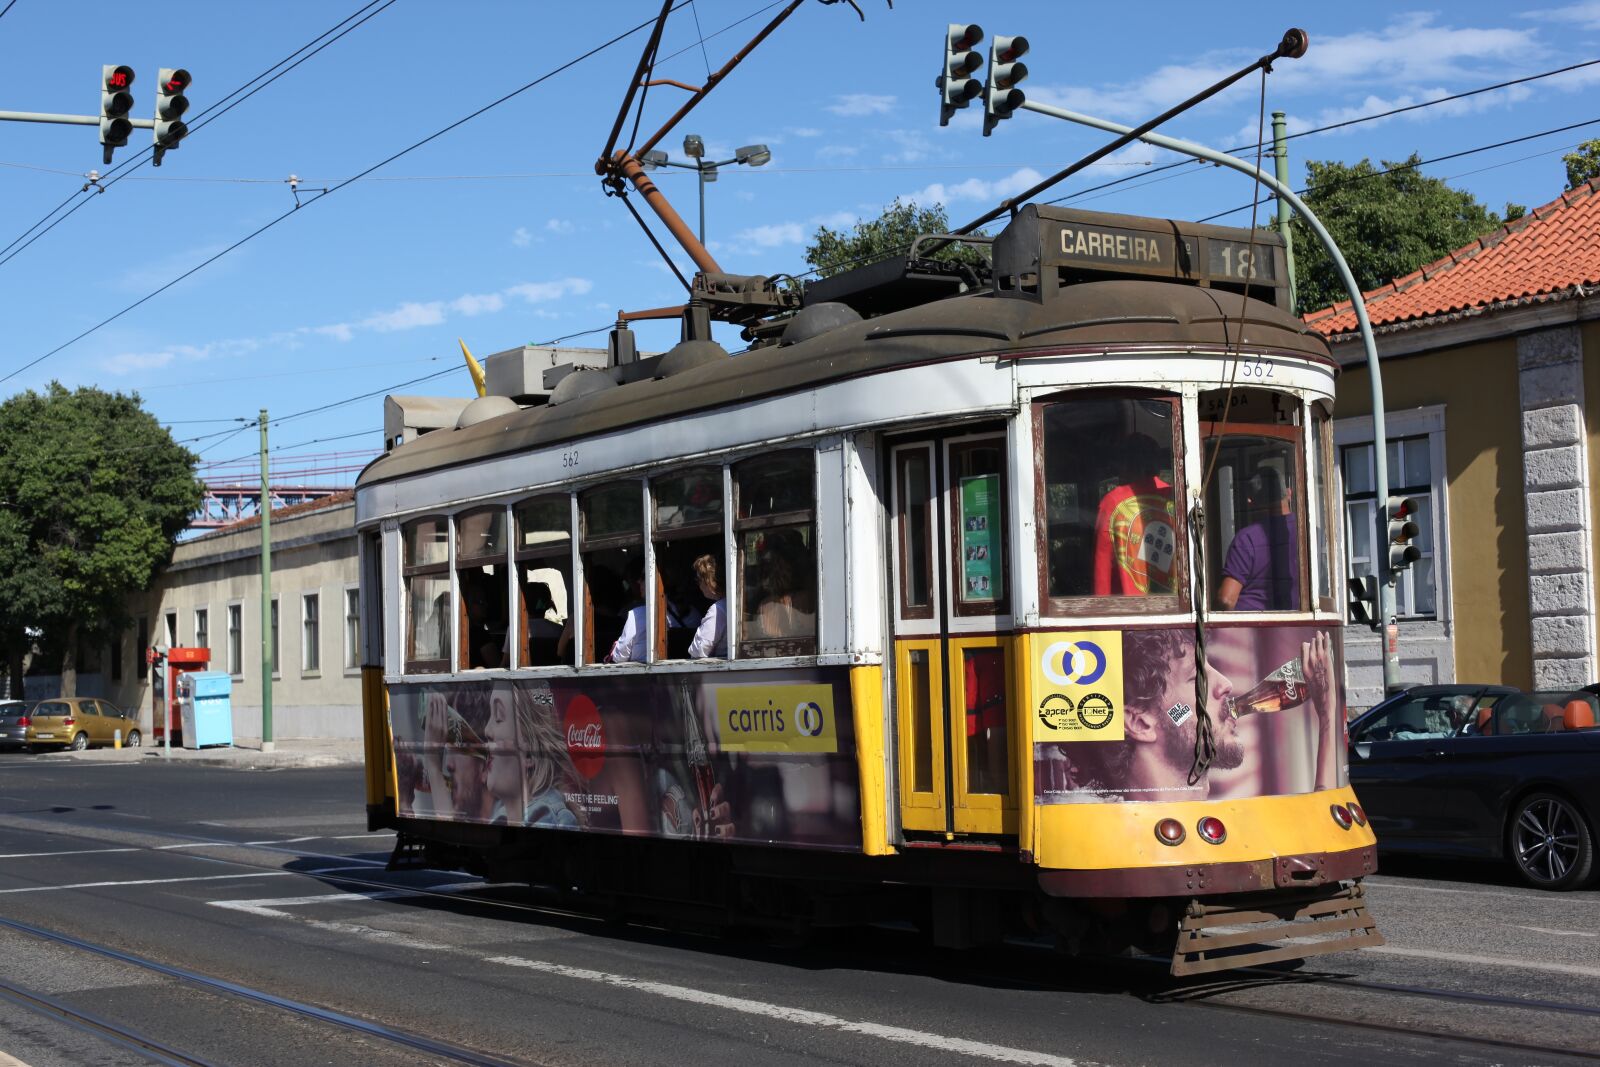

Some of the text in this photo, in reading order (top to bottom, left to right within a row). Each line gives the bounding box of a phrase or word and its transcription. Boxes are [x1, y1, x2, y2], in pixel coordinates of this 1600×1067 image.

[1061, 229, 1160, 262] CARREIRA
[1221, 247, 1257, 280] 18
[1243, 359, 1274, 378] 562
[1209, 393, 1248, 410] SADA
[563, 450, 579, 468] 562
[728, 700, 785, 732] carris
[1045, 708, 1069, 718] apcer
[564, 792, 619, 805] TASTE THE FEELING
